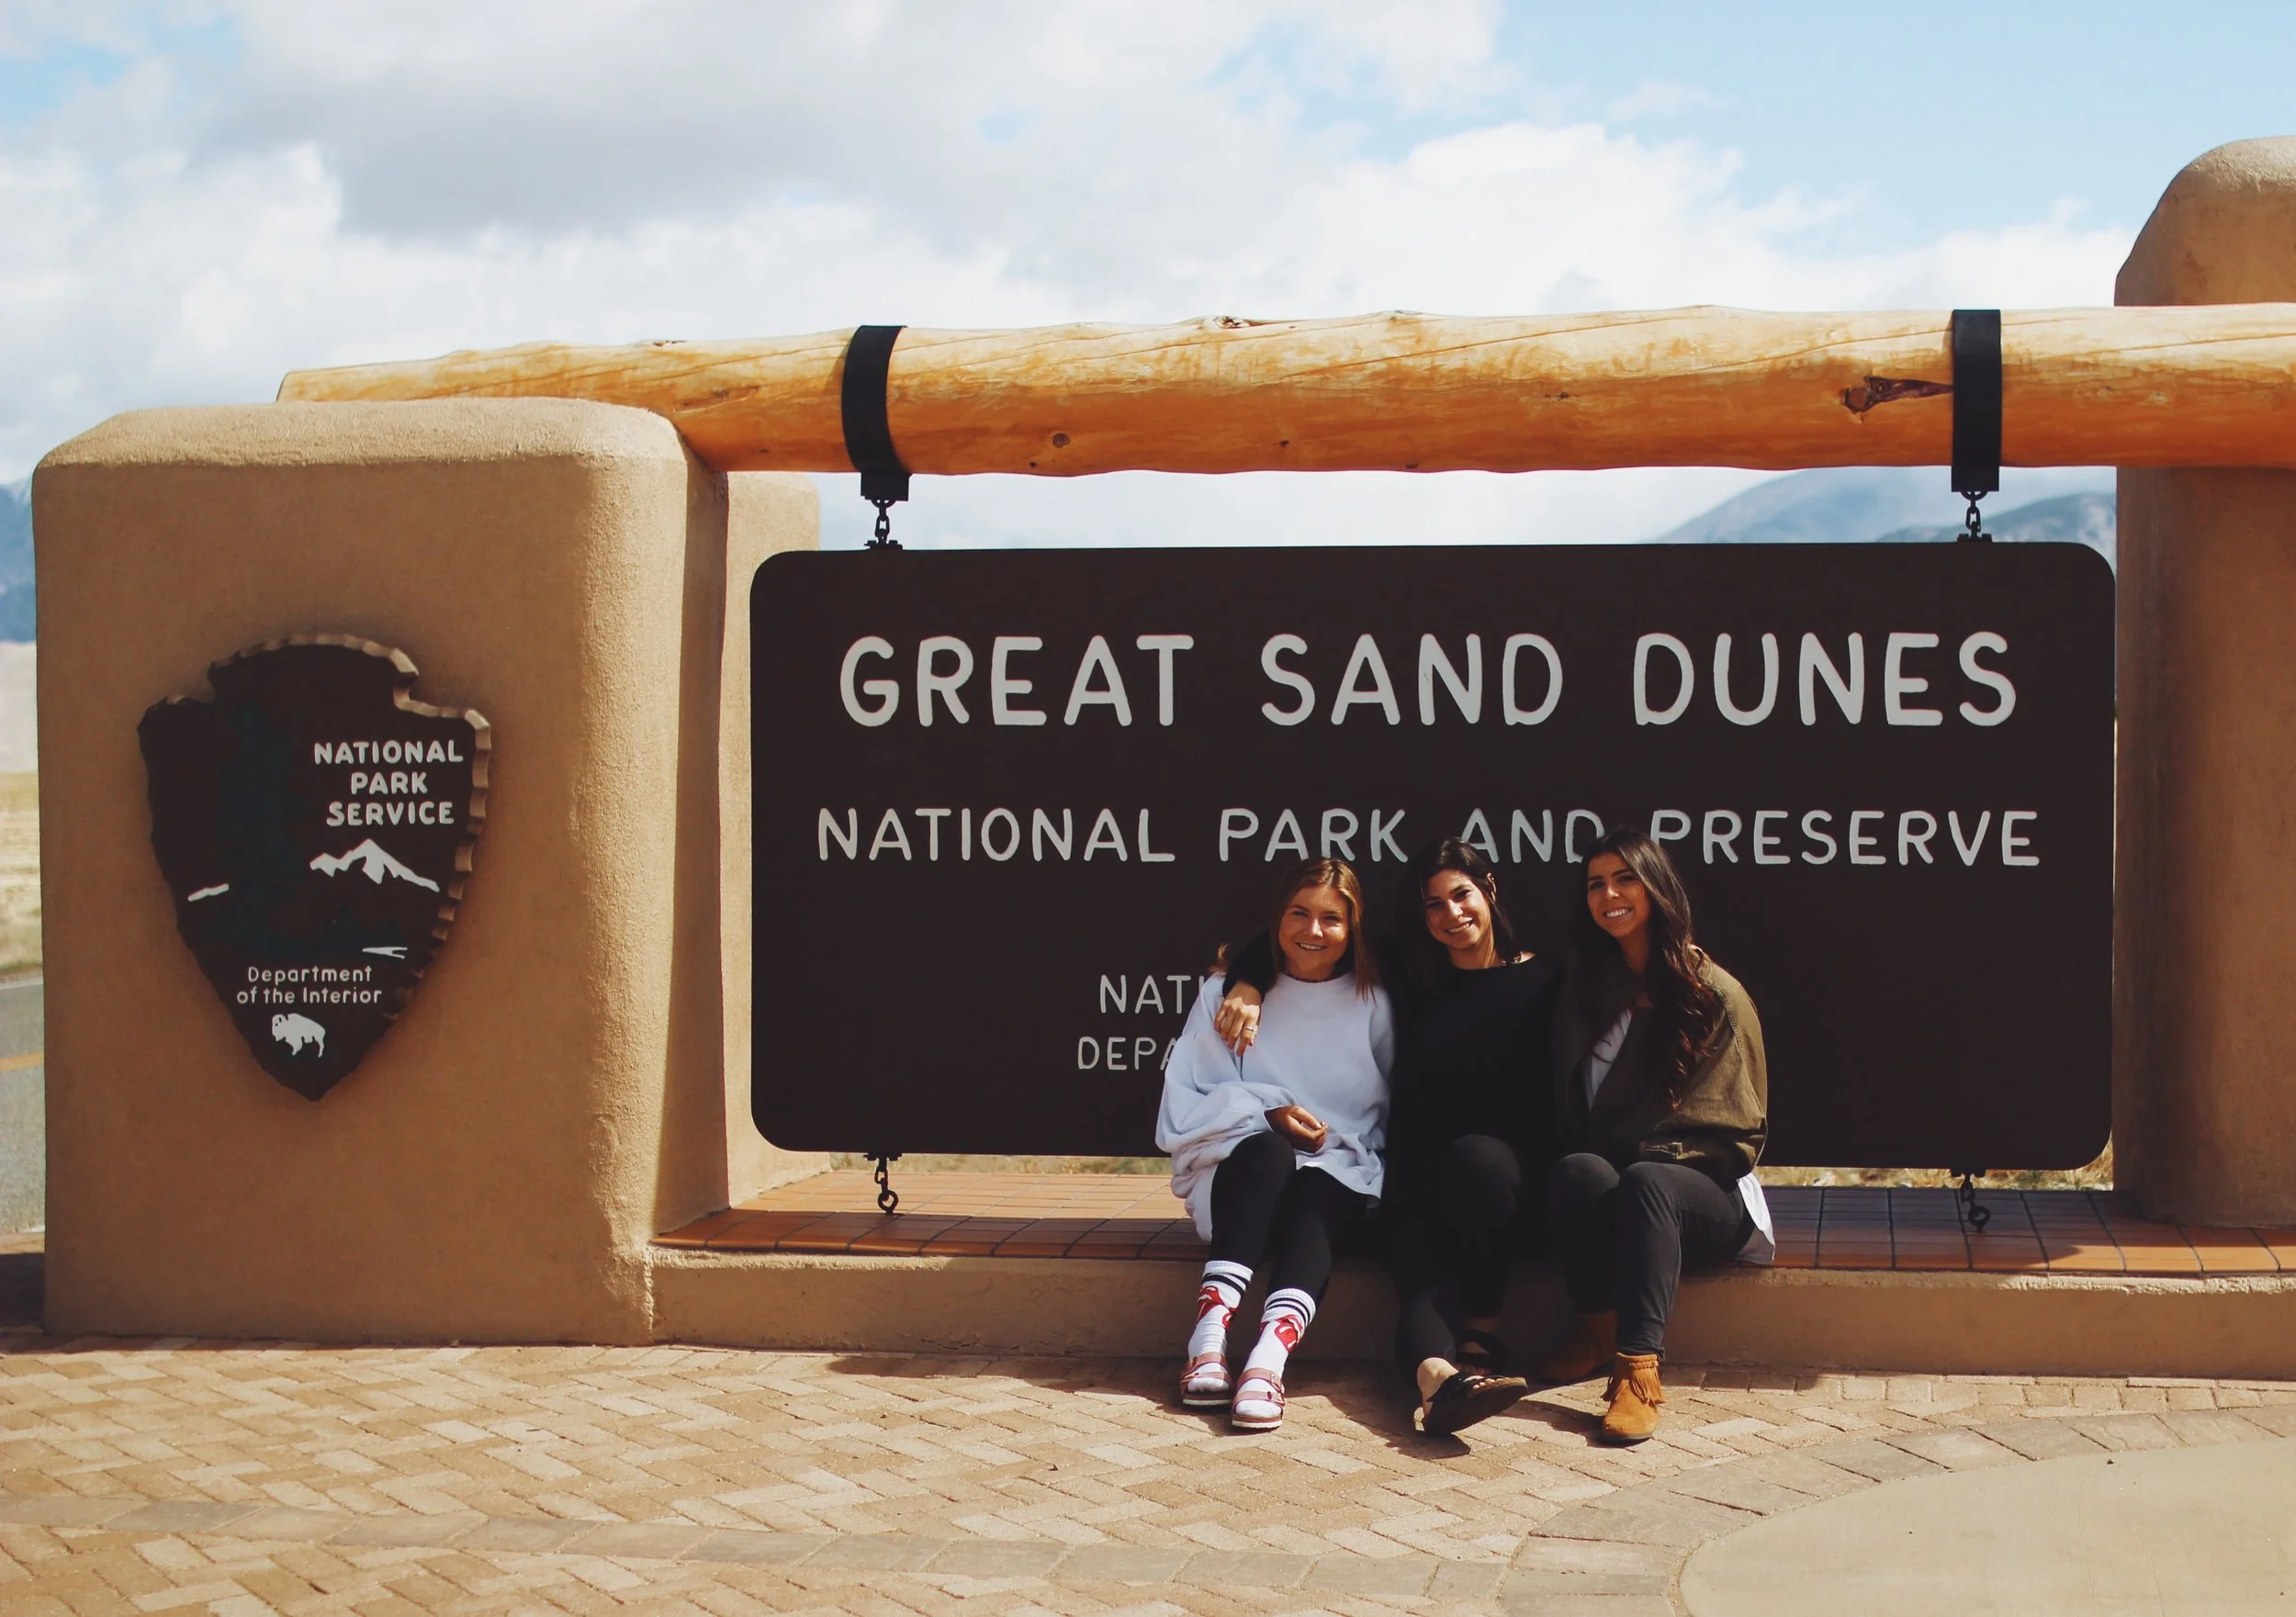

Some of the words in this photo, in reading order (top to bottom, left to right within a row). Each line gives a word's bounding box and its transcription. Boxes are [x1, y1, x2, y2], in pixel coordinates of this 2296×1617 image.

[839, 634, 1195, 727] GREAT
[1260, 633, 1563, 726] SAND
[1633, 631, 2017, 727] DUNES
[314, 739, 464, 765] NATIONAL
[350, 771, 428, 795] PARK
[326, 801, 455, 827] SERVICE
[817, 807, 1176, 863] NATIONAL
[1219, 807, 1409, 863] PARK
[1460, 807, 1605, 864] AND
[1649, 809, 2041, 867] PRESERVE
[247, 965, 372, 986] Department
[236, 985, 258, 1005] of
[263, 987, 296, 1005] the
[302, 986, 383, 1004] Interior
